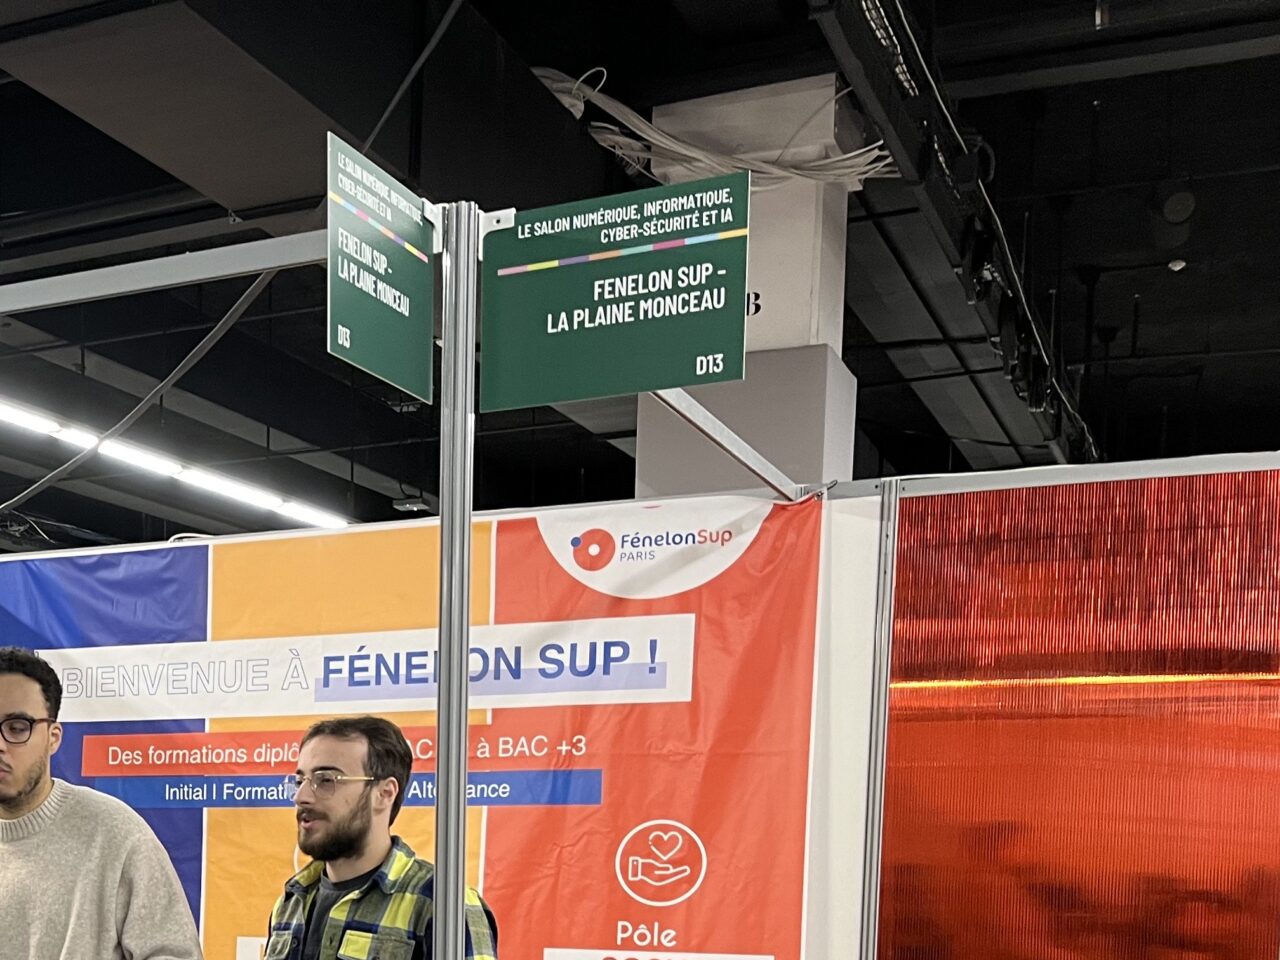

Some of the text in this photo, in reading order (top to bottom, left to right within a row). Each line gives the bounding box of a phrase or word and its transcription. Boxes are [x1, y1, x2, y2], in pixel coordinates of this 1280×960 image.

[518, 188, 733, 239] LE SALON NUMÉRIQUE, INFORMATIQUE,
[600, 207, 733, 244] CYBER-SÉCURITÉ ET IA
[338, 227, 373, 268] FENELON
[373, 249, 388, 275] SUP
[338, 255, 410, 317] LA PLAINE MONCEAU
[593, 269, 673, 301] FENELON
[677, 262, 714, 287] SUP
[547, 287, 726, 334] LA PLAINE MONCEAU
[337, 324, 351, 348] D13
[696, 353, 724, 375] D13
[620, 550, 656, 562] PARIS
[621, 529, 733, 549] FénelonSup
[62, 638, 658, 699] BIENVENUE À FÉNEON SUP !
[108, 746, 143, 765] Des
[148, 743, 247, 765] formations
[253, 742, 300, 768] diplô
[476, 737, 491, 758] à
[498, 735, 548, 758] BAC
[556, 735, 587, 756] +3
[165, 783, 208, 801] Initial
[223, 783, 288, 800] Formati
[616, 920, 677, 947] Pôle
